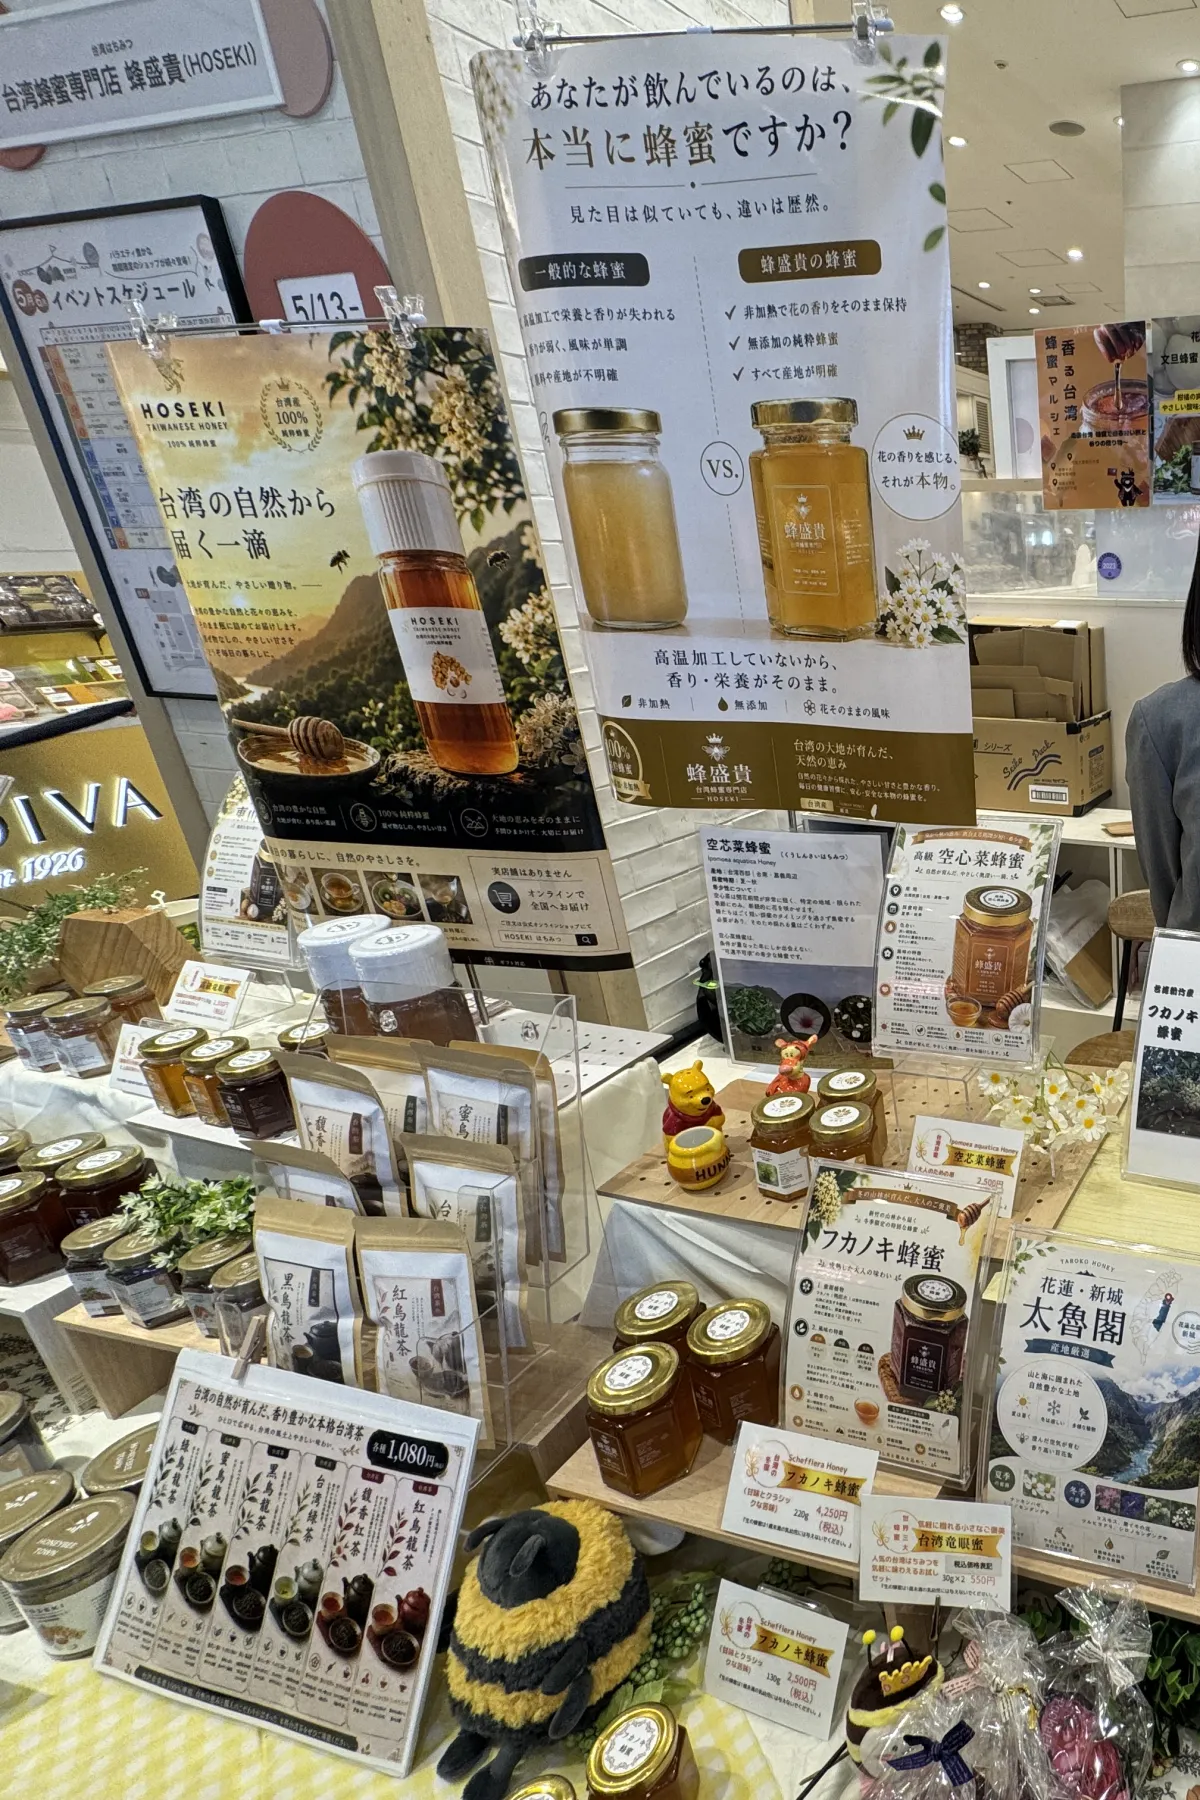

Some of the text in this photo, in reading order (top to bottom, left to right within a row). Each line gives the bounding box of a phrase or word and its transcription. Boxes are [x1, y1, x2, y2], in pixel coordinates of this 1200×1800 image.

[2, 41, 257, 113] 台湾蜂蜜専門店 蜂盛貴(HOSEKI)
[530, 66, 851, 111] あなたが飲んでいるのは、
[522, 109, 854, 171] 本当に蜂蜜ですか？
[570, 194, 829, 224] 見た目は似ていても、違いは歴然。
[535, 260, 626, 281] 一般的な蜂蜜
[760, 249, 857, 275] 蜂盛貴の蜂蜜
[523, 308, 675, 327] 高温加工で栄養と香りが失われる
[743, 297, 907, 320] 非加熱で花の香りをそのまま保持
[529, 338, 628, 357] 香りが弱く、風味が単調
[747, 331, 839, 350] 無添加の純粋蜂蜜
[535, 368, 619, 386] 原料や産地が不明確
[751, 363, 838, 380] すべて産地が明確
[1062, 340, 1077, 421] 香る台湾
[1045, 336, 1060, 435] 蜂蜜マルシェ
[141, 401, 225, 419] HOSEKI
[275, 398, 302, 408] 台湾産
[146, 422, 228, 431] TAIWANESE HONEY
[275, 411, 308, 425] 100%
[167, 440, 186, 448] 100%
[877, 450, 958, 466] 花の香りを感じる、
[706, 458, 739, 480] VS.
[880, 472, 957, 491] それが本物。
[159, 487, 335, 519] 台湾の自然から
[784, 522, 826, 540] 蜂盛貴
[171, 529, 271, 560] 届く一滴
[654, 649, 837, 671] 高温加工していないから、
[666, 672, 839, 694] 香り・栄養がそのまま。
[638, 698, 670, 711] 非加熱
[734, 699, 768, 711] 無添加
[820, 703, 891, 720] 花そのままの風味
[793, 740, 894, 760] 台湾の大地が育んだ、
[984, 742, 1012, 751] シリーズ
[795, 755, 847, 770] 天然の恵み
[687, 764, 752, 783] 蜂盛貴
[0, 778, 163, 847] IVA
[707, 838, 771, 855] 空芯菜蜂蜜
[780, 851, 849, 861] （くうしんさいはちみつ）
[22, 848, 85, 883] 1926
[914, 847, 1025, 869] 高級 空心菜蜂蜜
[491, 867, 571, 878] 実店舗はありません
[528, 889, 585, 898] オンラインで
[530, 902, 589, 911] 全国へお届け
[1149, 1005, 1199, 1023] フカノキ
[1157, 1025, 1183, 1041] 蜂蜜
[954, 1151, 1006, 1169] 空芯菜蜂蜜
[822, 1229, 945, 1272] フカノキ蜂蜜
[1092, 1261, 1115, 1273] HONEY
[1041, 1276, 1124, 1306] 花蓮・新城
[392, 1285, 410, 1356] 紅烏龍茶
[1020, 1296, 1126, 1345] 太魯閣
[1050, 1343, 1090, 1359] 産地厳選
[1028, 1371, 1083, 1387] 山と海に囲まれた
[1029, 1382, 1080, 1397] 自然豊かな土地
[194, 1385, 365, 1442] 台湾の自然が育んだ、香り豊かな本格台湾茶
[372, 1440, 435, 1468] 各種 1,080円
[207, 1451, 228, 1518] 蜜烏龍茶
[787, 1471, 860, 1498] フカノキ蜂蜜
[302, 1474, 324, 1543] 台湾緑茶
[794, 1506, 848, 1520] 220g 4,250円
[402, 1500, 425, 1571] 紅烏龍茶
[819, 1521, 843, 1536] （税込）
[918, 1534, 983, 1551] 台湾竜眼蜜
[872, 1555, 938, 1567] 人気の台湾はちみつを
[872, 1565, 938, 1576] 気軽に味わえるお試し
[954, 1560, 993, 1570] 税込価格表記
[872, 1575, 891, 1583] セット
[943, 1575, 996, 1585] 30g×2 550円
[759, 1635, 828, 1669] フカノキ蜂蜜
[767, 1672, 817, 1691] 130g 2,500円
